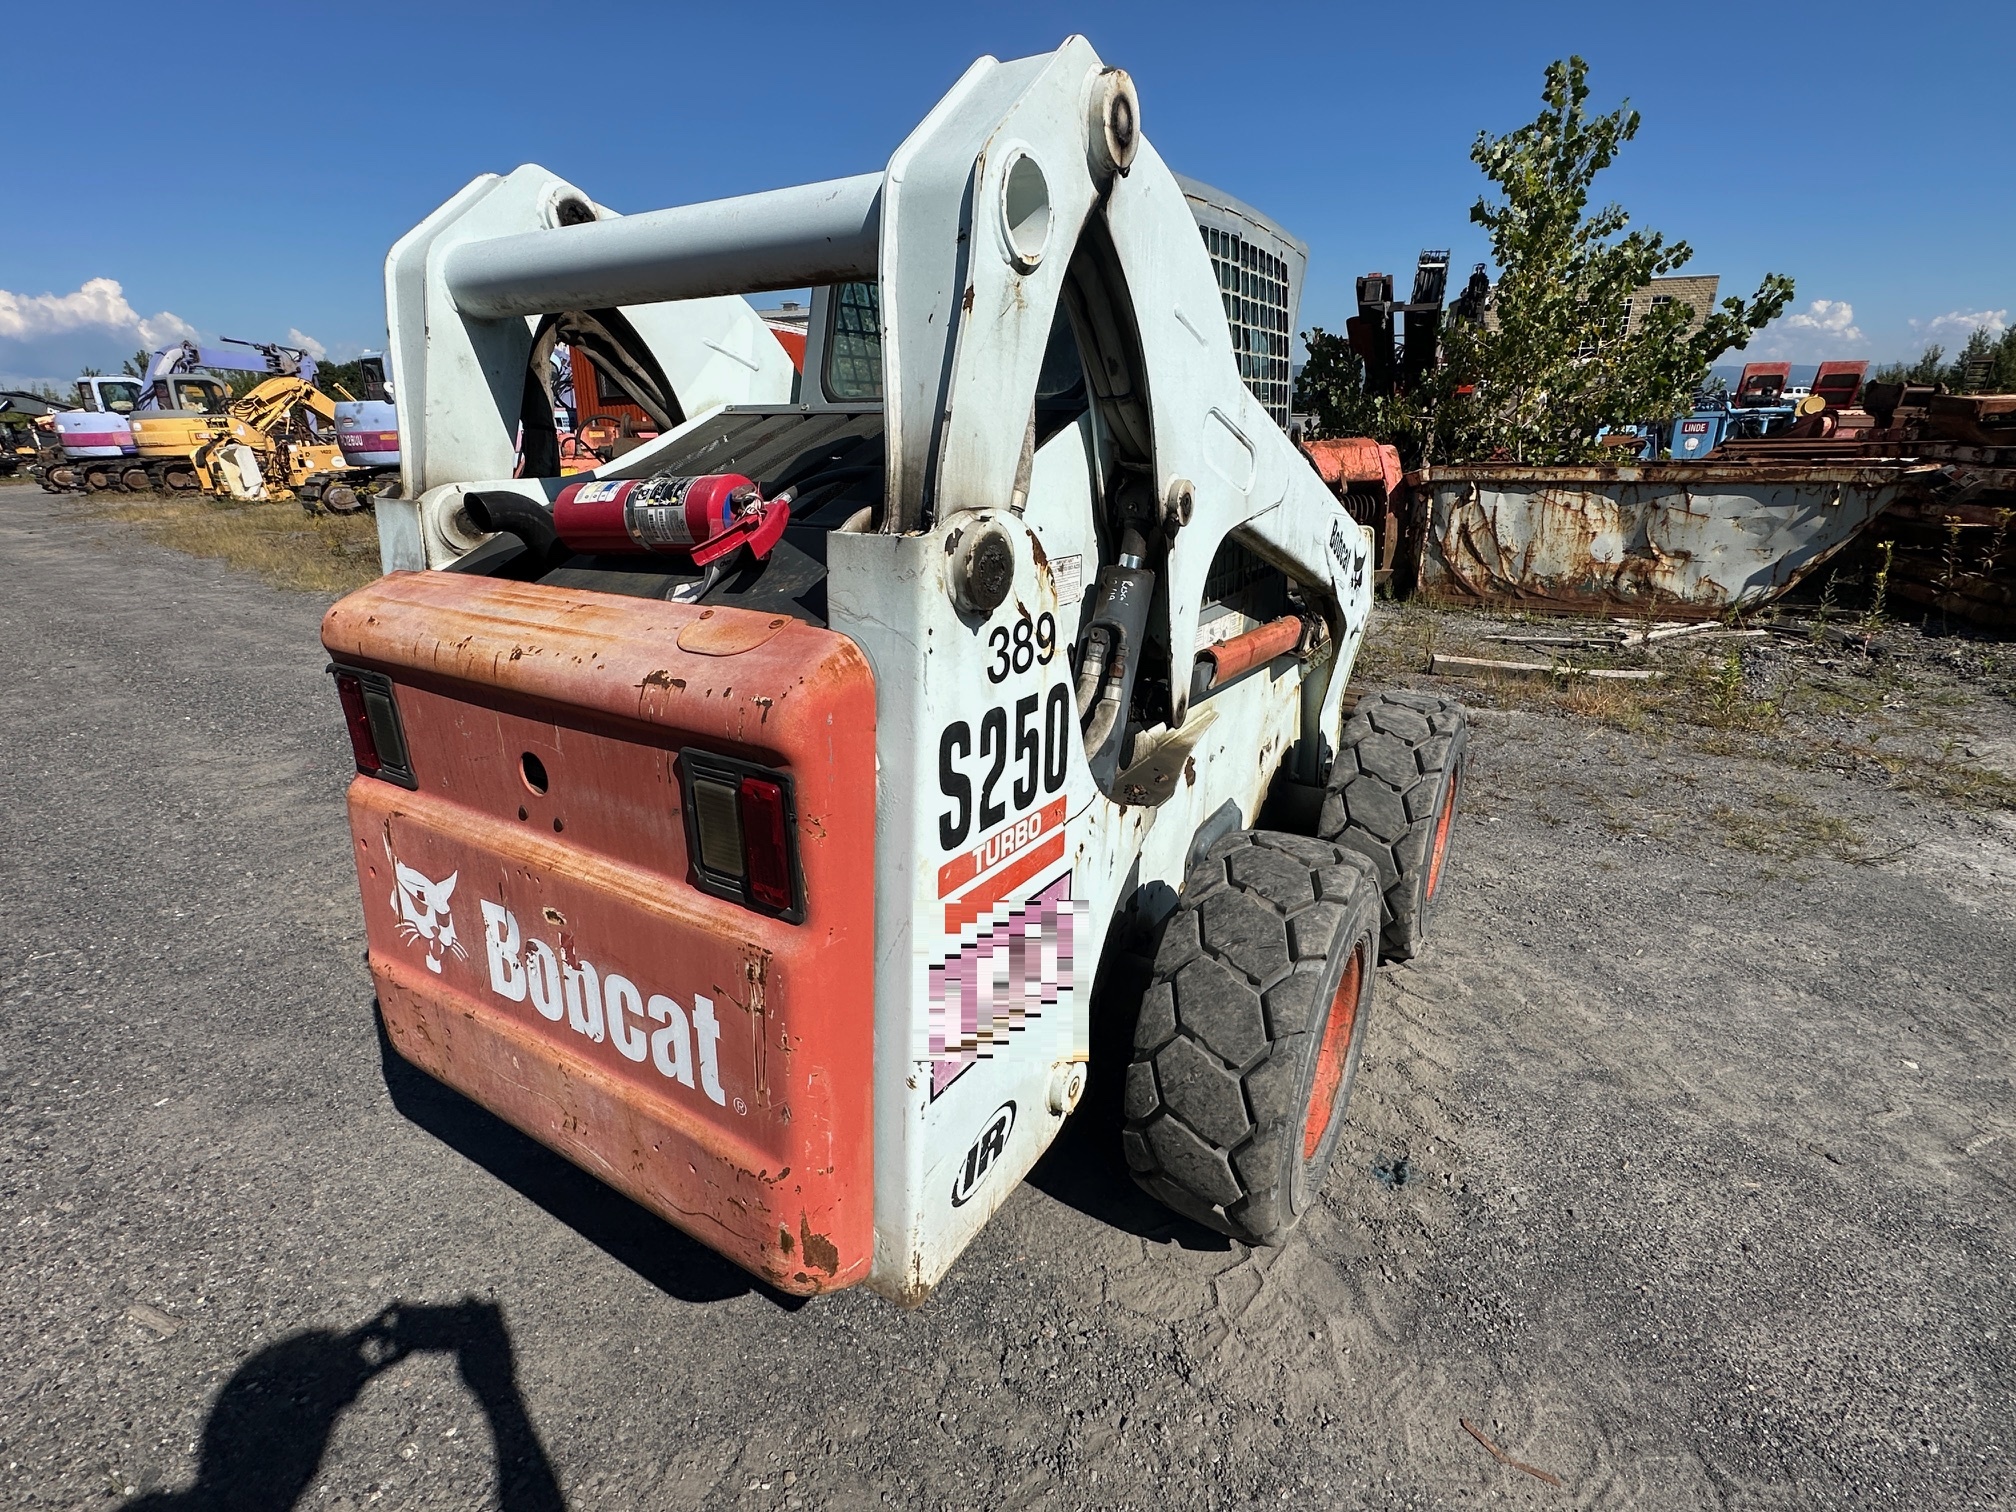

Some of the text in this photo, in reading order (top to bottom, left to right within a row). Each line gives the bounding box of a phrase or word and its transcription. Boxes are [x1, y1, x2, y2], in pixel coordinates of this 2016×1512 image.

[1684, 423, 1706, 433] LINDE
[1329, 518, 1352, 575] Bobcat
[987, 611, 1056, 684] 389
[939, 682, 1070, 851] S250
[972, 813, 1043, 874] TURBO
[480, 899, 726, 1107] Bobcat
[963, 1115, 1008, 1195] IR
